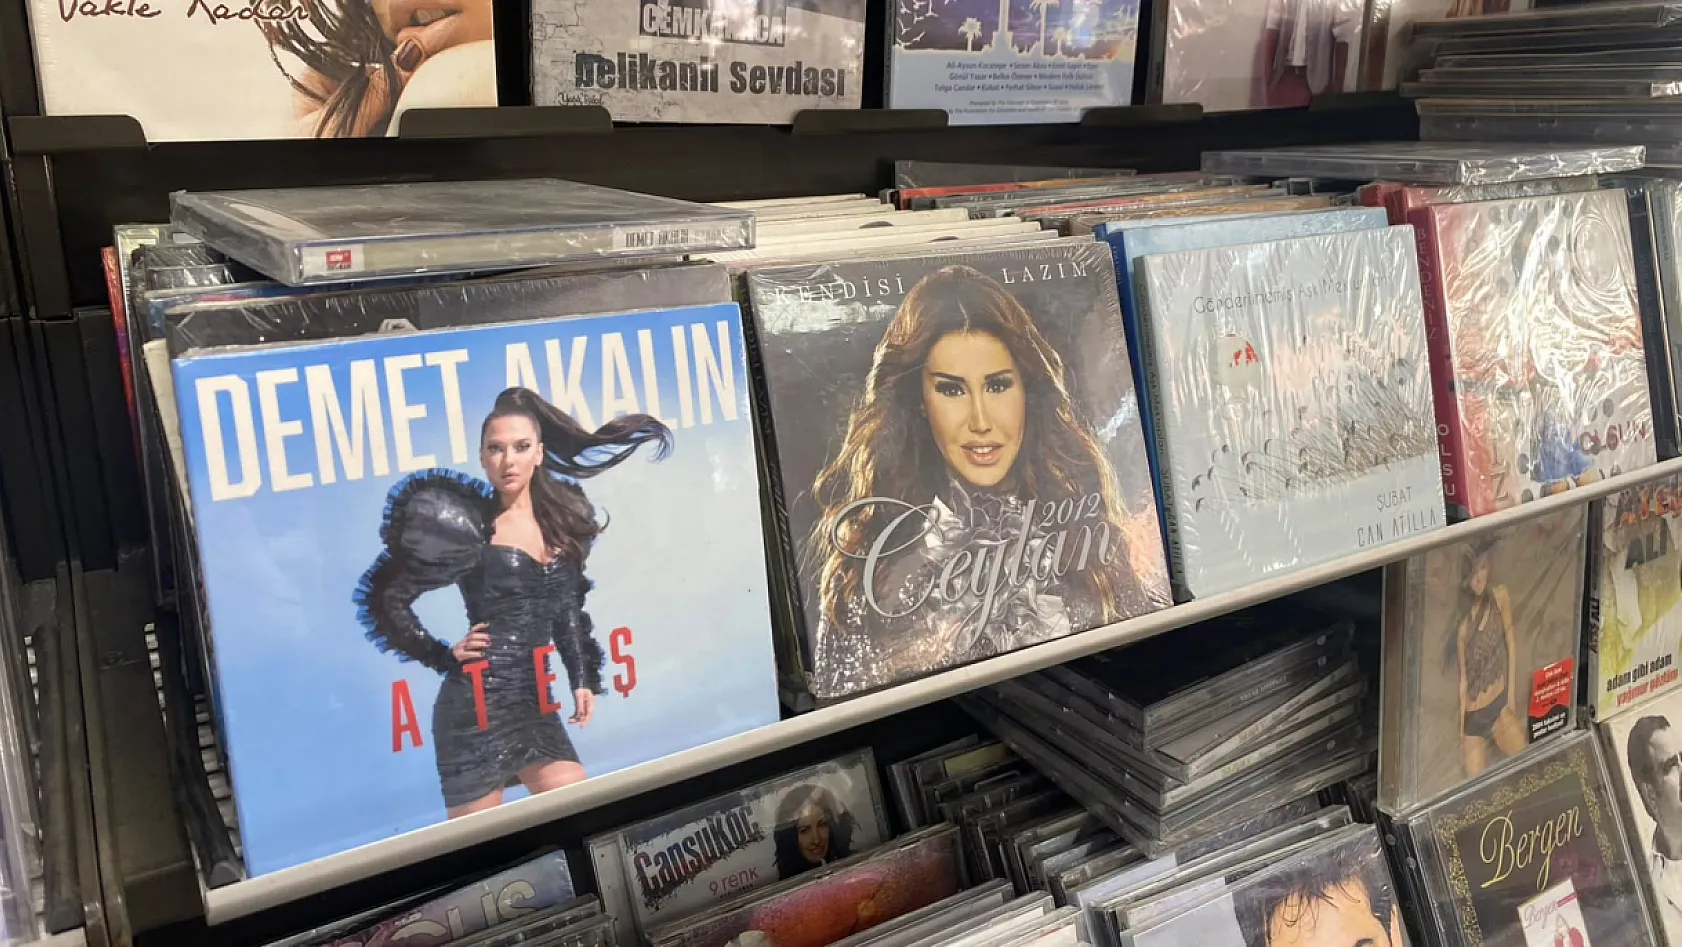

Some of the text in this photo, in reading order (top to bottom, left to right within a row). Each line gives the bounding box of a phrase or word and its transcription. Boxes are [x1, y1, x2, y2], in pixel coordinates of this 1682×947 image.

[730, 60, 845, 98] Sevdası
[1002, 261, 1089, 285] LAZIM
[195, 349, 469, 502] DEMET
[1437, 424, 1457, 497] OLSU
[1041, 492, 1101, 528] 2012
[1357, 521, 1384, 548] CAN
[831, 496, 1120, 651] Ceylan
[390, 626, 638, 753] ATEŞ
[1606, 672, 1632, 692] adam
[1650, 654, 1672, 673] adam
[1479, 804, 1584, 891] Bergen
[722, 867, 760, 891] renk
